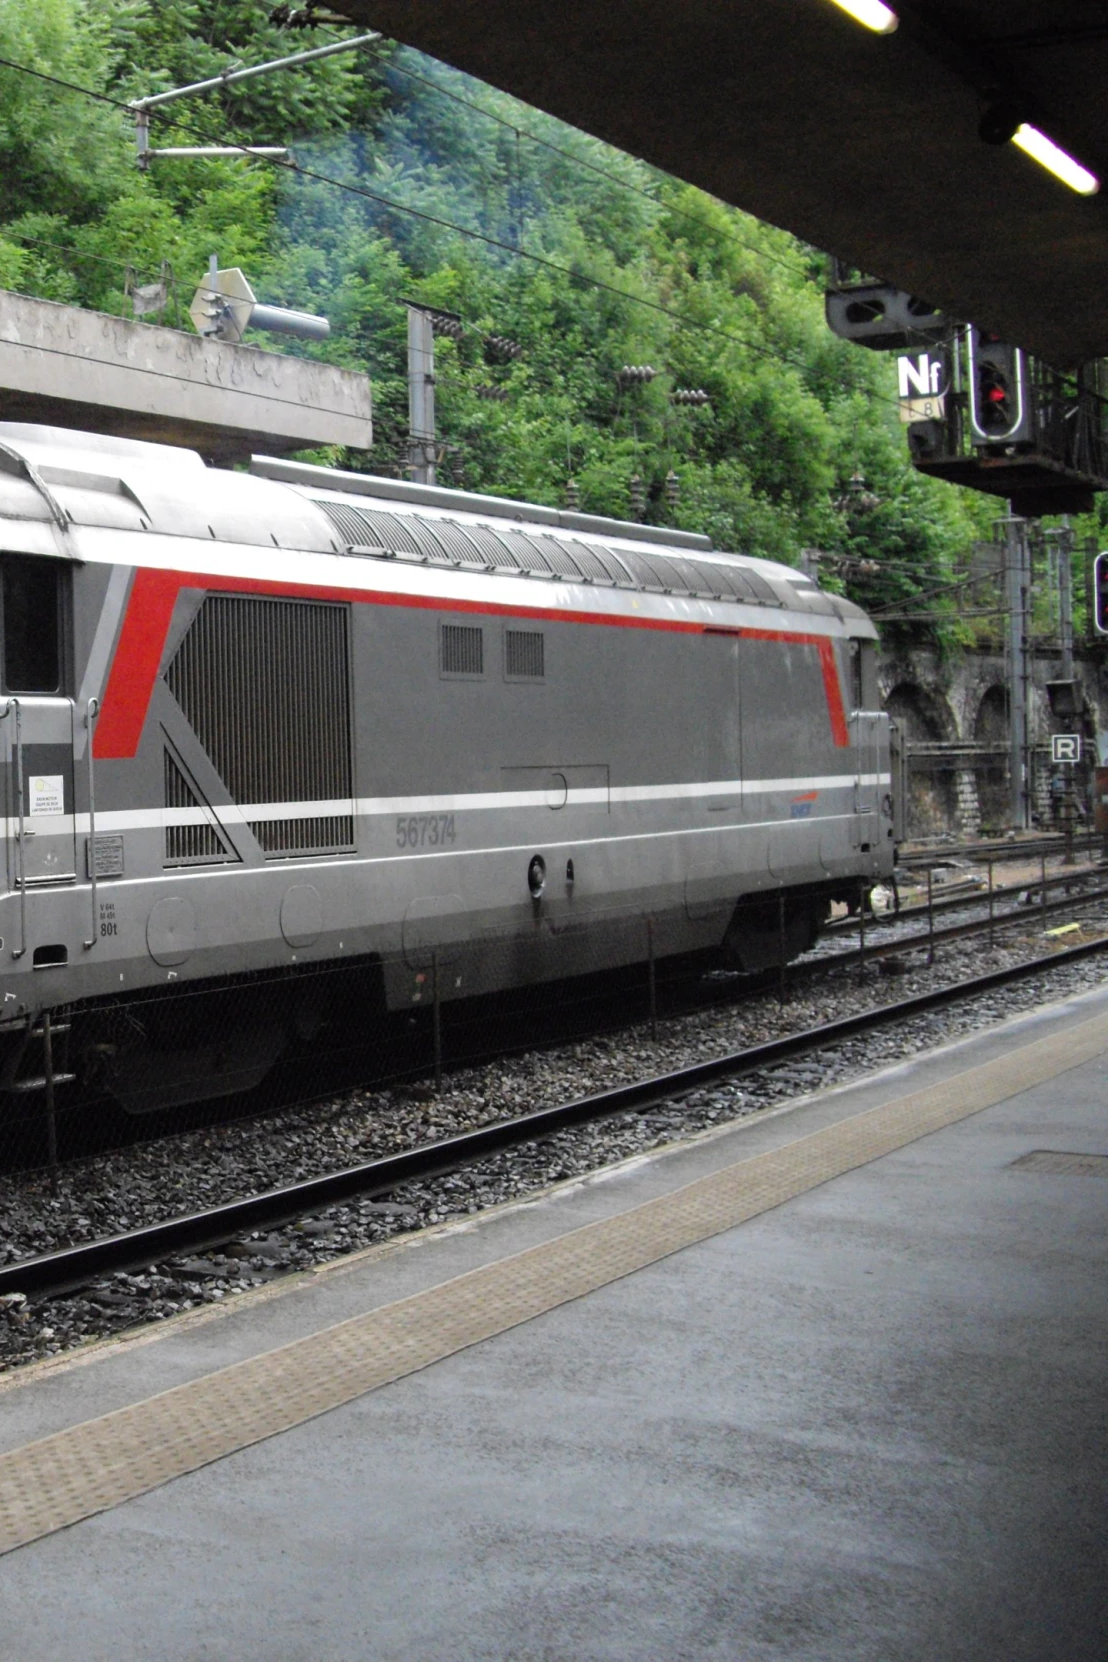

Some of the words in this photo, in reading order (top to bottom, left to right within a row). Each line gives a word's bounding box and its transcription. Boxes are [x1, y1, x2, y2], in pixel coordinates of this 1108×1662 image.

[897, 353, 941, 397] Nf
[1057, 738, 1075, 758] R
[396, 814, 456, 848] 567374
[100, 922, 118, 937] 80t
